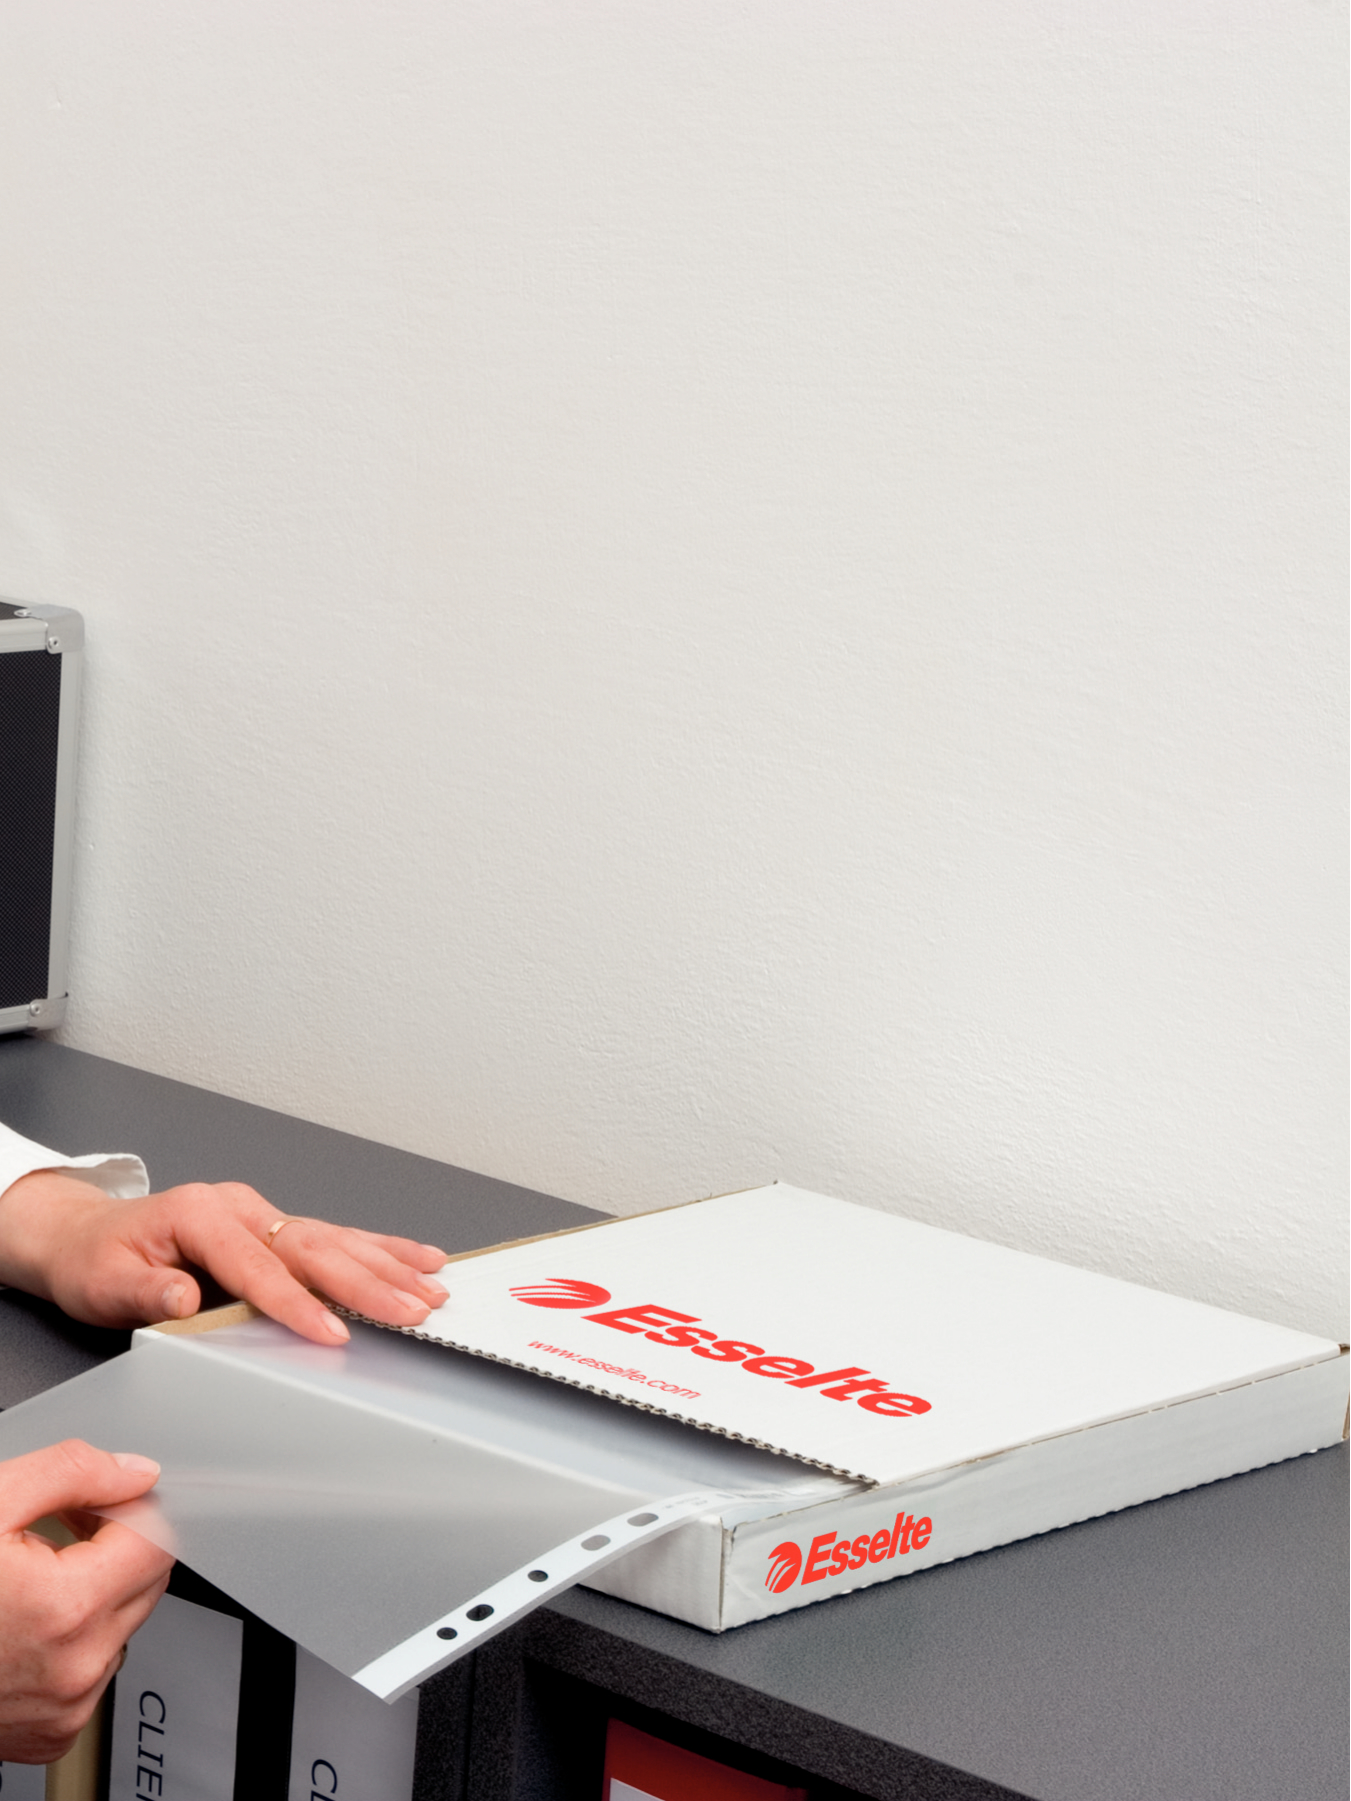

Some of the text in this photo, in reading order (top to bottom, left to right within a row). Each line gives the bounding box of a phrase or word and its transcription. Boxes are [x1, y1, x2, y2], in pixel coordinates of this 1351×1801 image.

[527, 1341, 701, 1399] www.esselte.com
[581, 1304, 932, 1418] Esselte
[801, 1511, 932, 1585] Esselte
